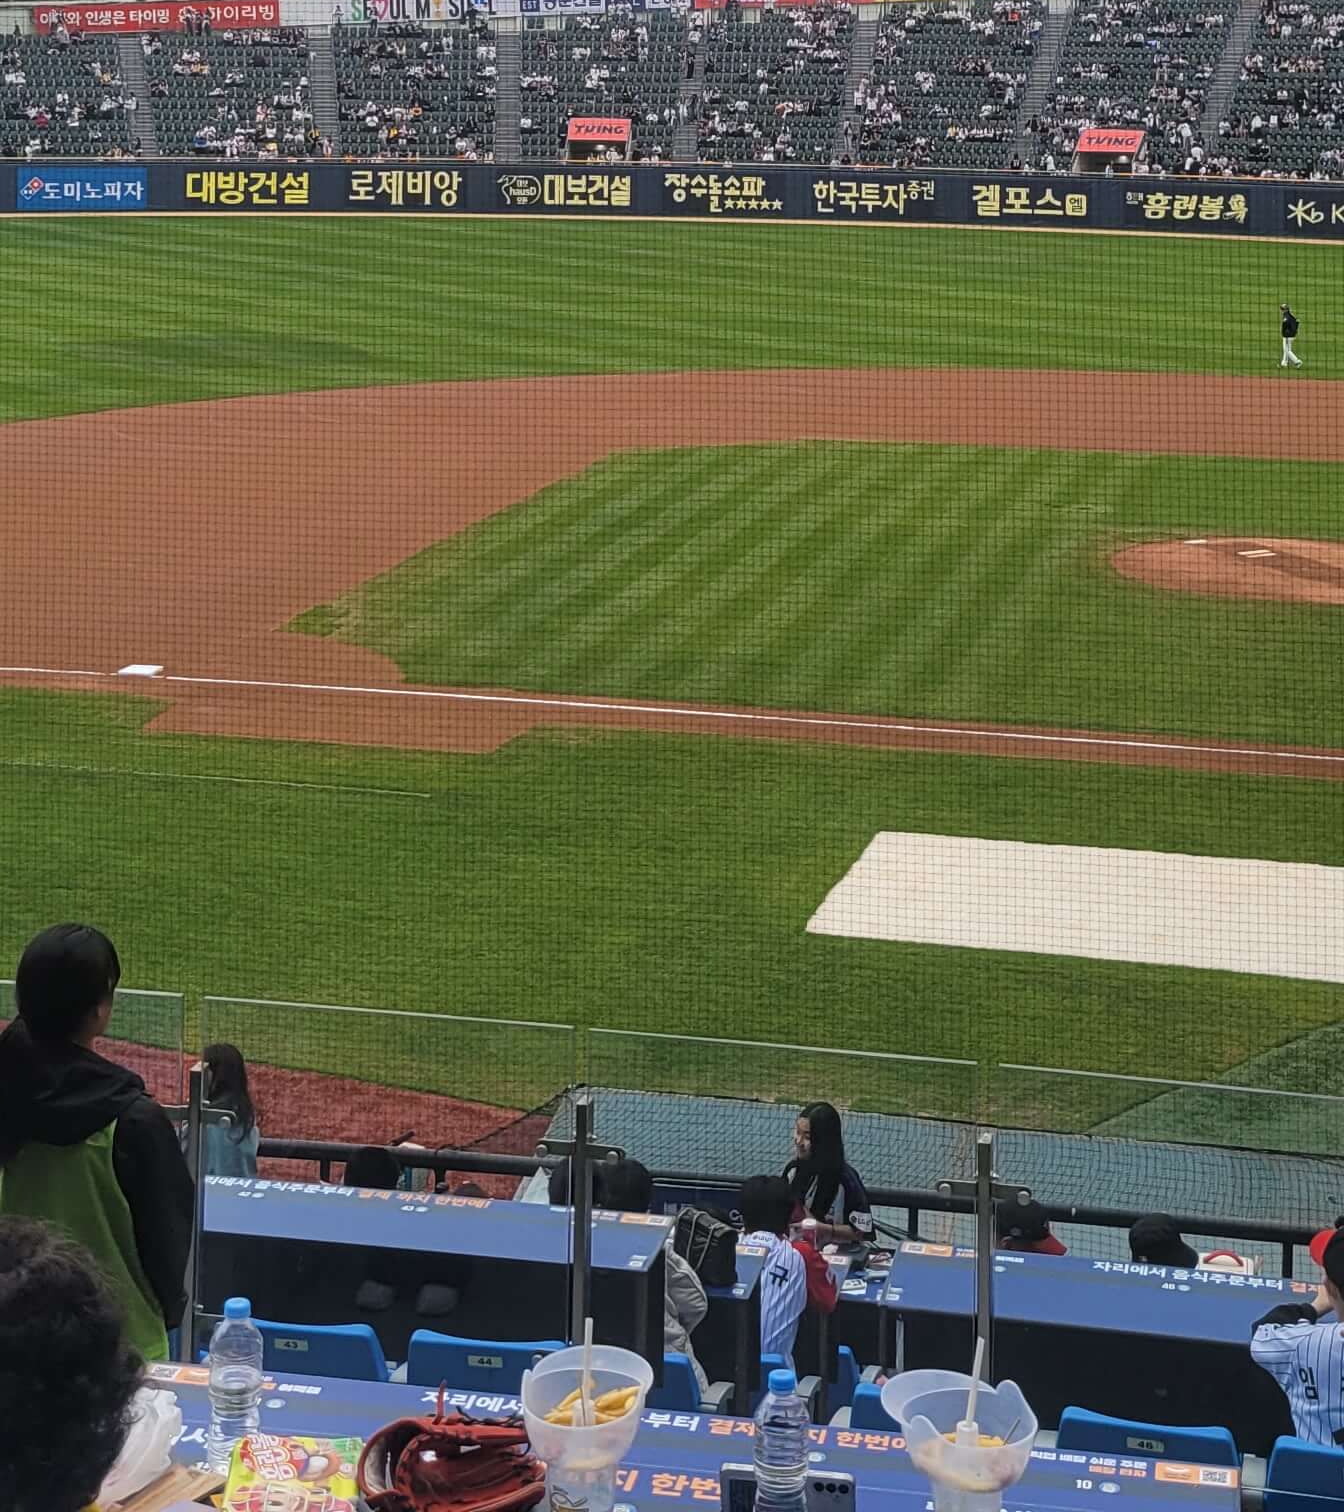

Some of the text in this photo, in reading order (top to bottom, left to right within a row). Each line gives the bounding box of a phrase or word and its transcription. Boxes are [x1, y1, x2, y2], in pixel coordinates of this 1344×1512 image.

[84, 8, 127, 27] 인생은
[128, 7, 171, 25] 타이밍
[1084, 134, 1138, 148] TVING
[42, 179, 145, 202] 도미노피자
[185, 170, 311, 206] 대방건설
[348, 169, 463, 207] 로제비앙
[543, 174, 632, 207] 대보건설
[1092, 1260, 1167, 1279] 자리에서
[1171, 1267, 1284, 1292] 음식주문부터
[282, 1340, 300, 1350] 43
[476, 1356, 493, 1367] 44
[1136, 1440, 1155, 1450] 46
[1075, 1478, 1093, 1491] 10
